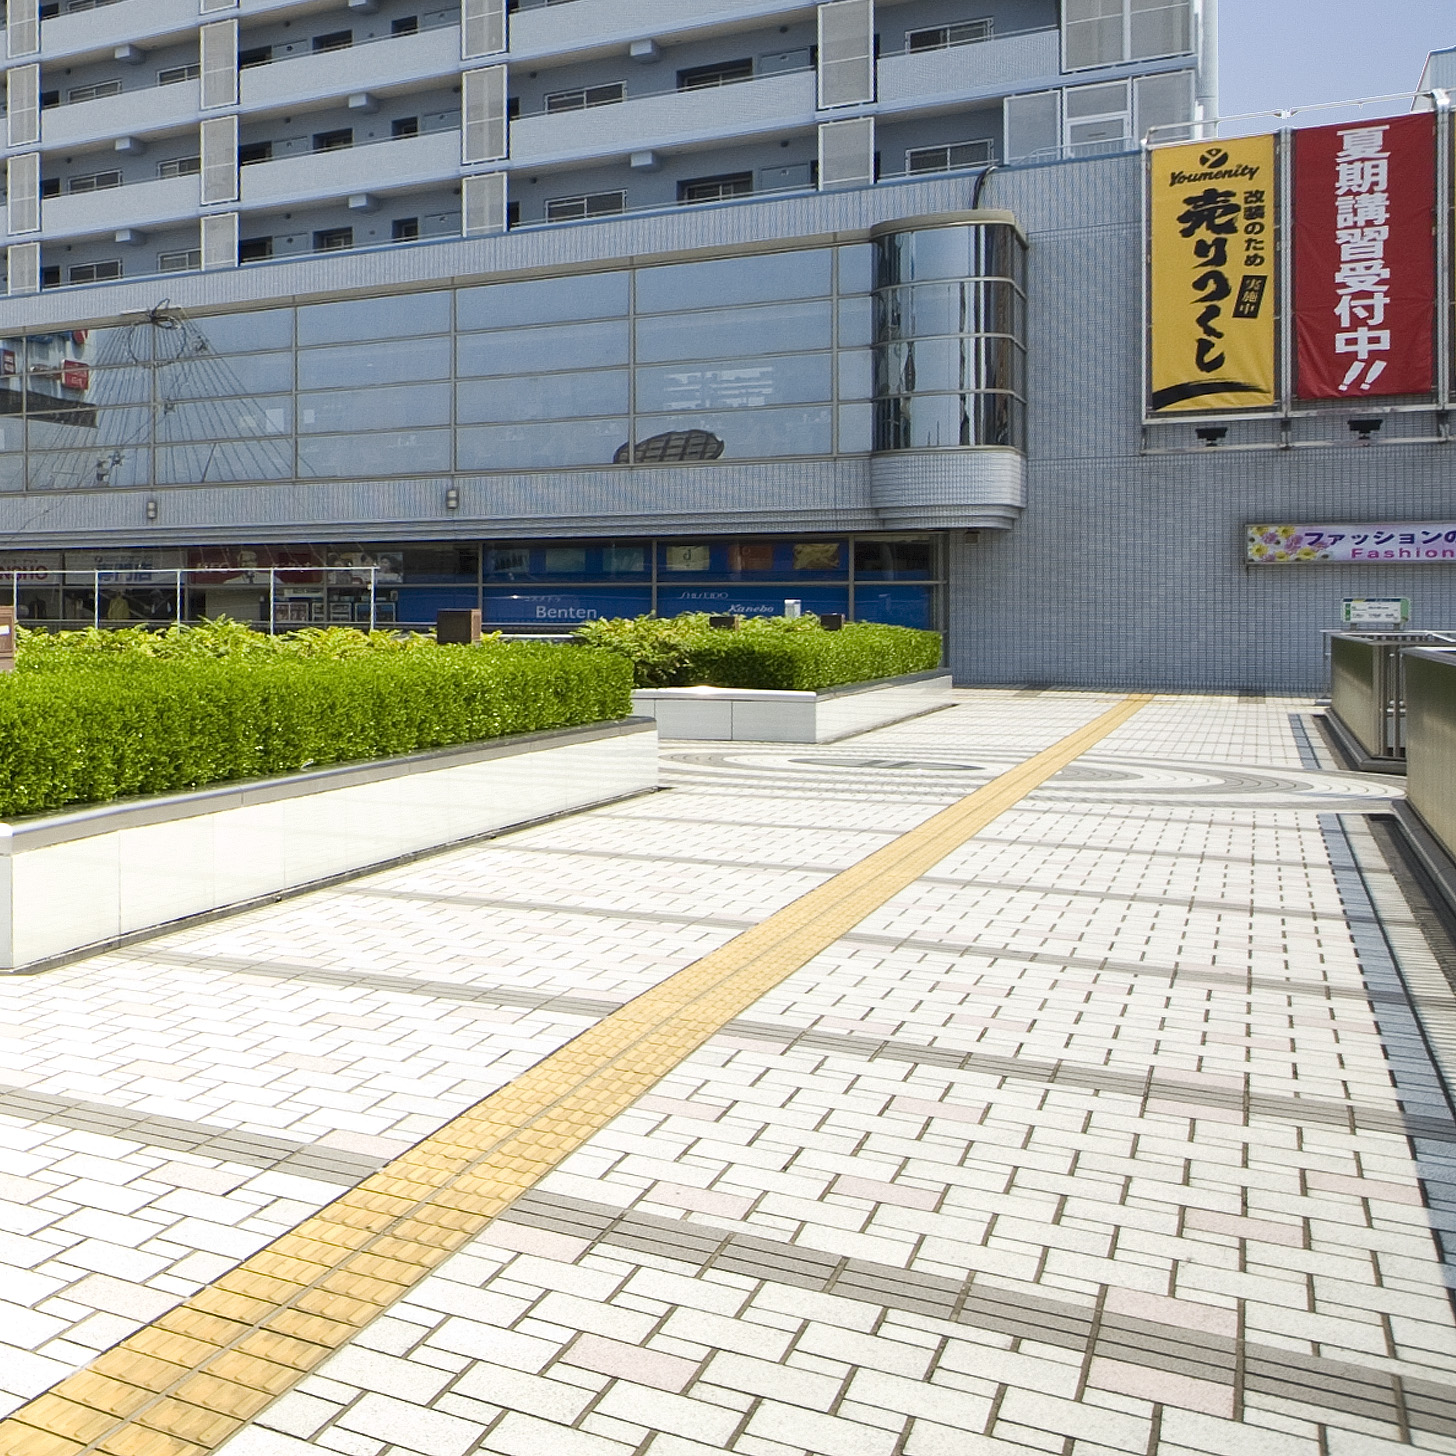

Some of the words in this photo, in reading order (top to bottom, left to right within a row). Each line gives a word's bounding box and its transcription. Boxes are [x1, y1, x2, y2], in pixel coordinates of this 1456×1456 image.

[1169, 162, 1260, 188] Youmenity
[1243, 189, 1265, 267] 改装のため
[1176, 187, 1242, 373] 売りつくし
[1351, 548, 1455, 559] Fashion
[535, 605, 598, 620] Benten
[728, 604, 775, 613] Kanebo
